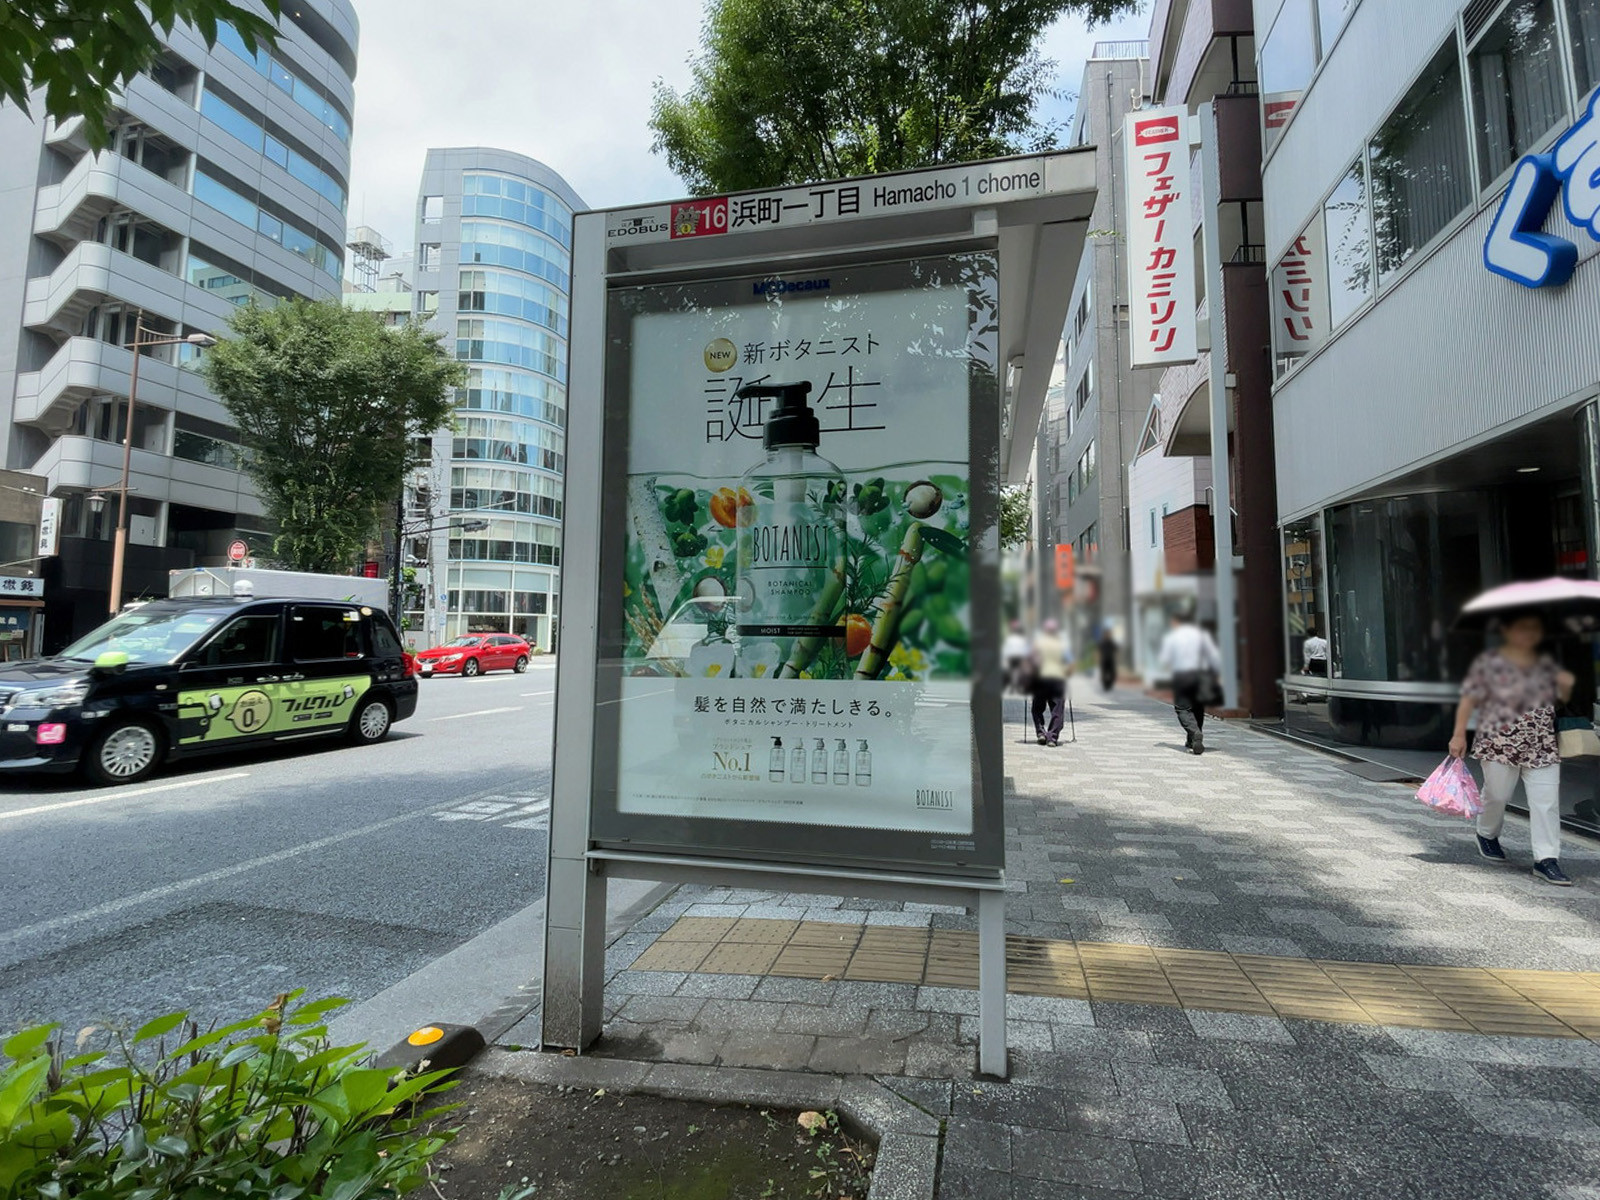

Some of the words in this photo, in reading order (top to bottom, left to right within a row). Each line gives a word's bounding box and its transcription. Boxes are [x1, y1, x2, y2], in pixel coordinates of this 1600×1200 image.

[701, 204, 726, 230] 16
[731, 186, 861, 228] 浜町一丁目
[873, 180, 956, 207] Hamacho
[961, 180, 969, 196] 1
[977, 172, 1040, 194] chome
[608, 223, 669, 237] EDOBUS
[1142, 151, 1181, 352] フェザーカミソリ
[709, 351, 731, 360] NEW
[743, 333, 880, 365] 新ボタニスト
[704, 365, 886, 443] 誕生
[753, 524, 829, 563] BOTANIST
[770, 588, 811, 596] SHAMPOO
[694, 695, 892, 718] 髪を自然で満たしきる。
[711, 751, 751, 772] No.1
[916, 789, 953, 807] BOTANIST
